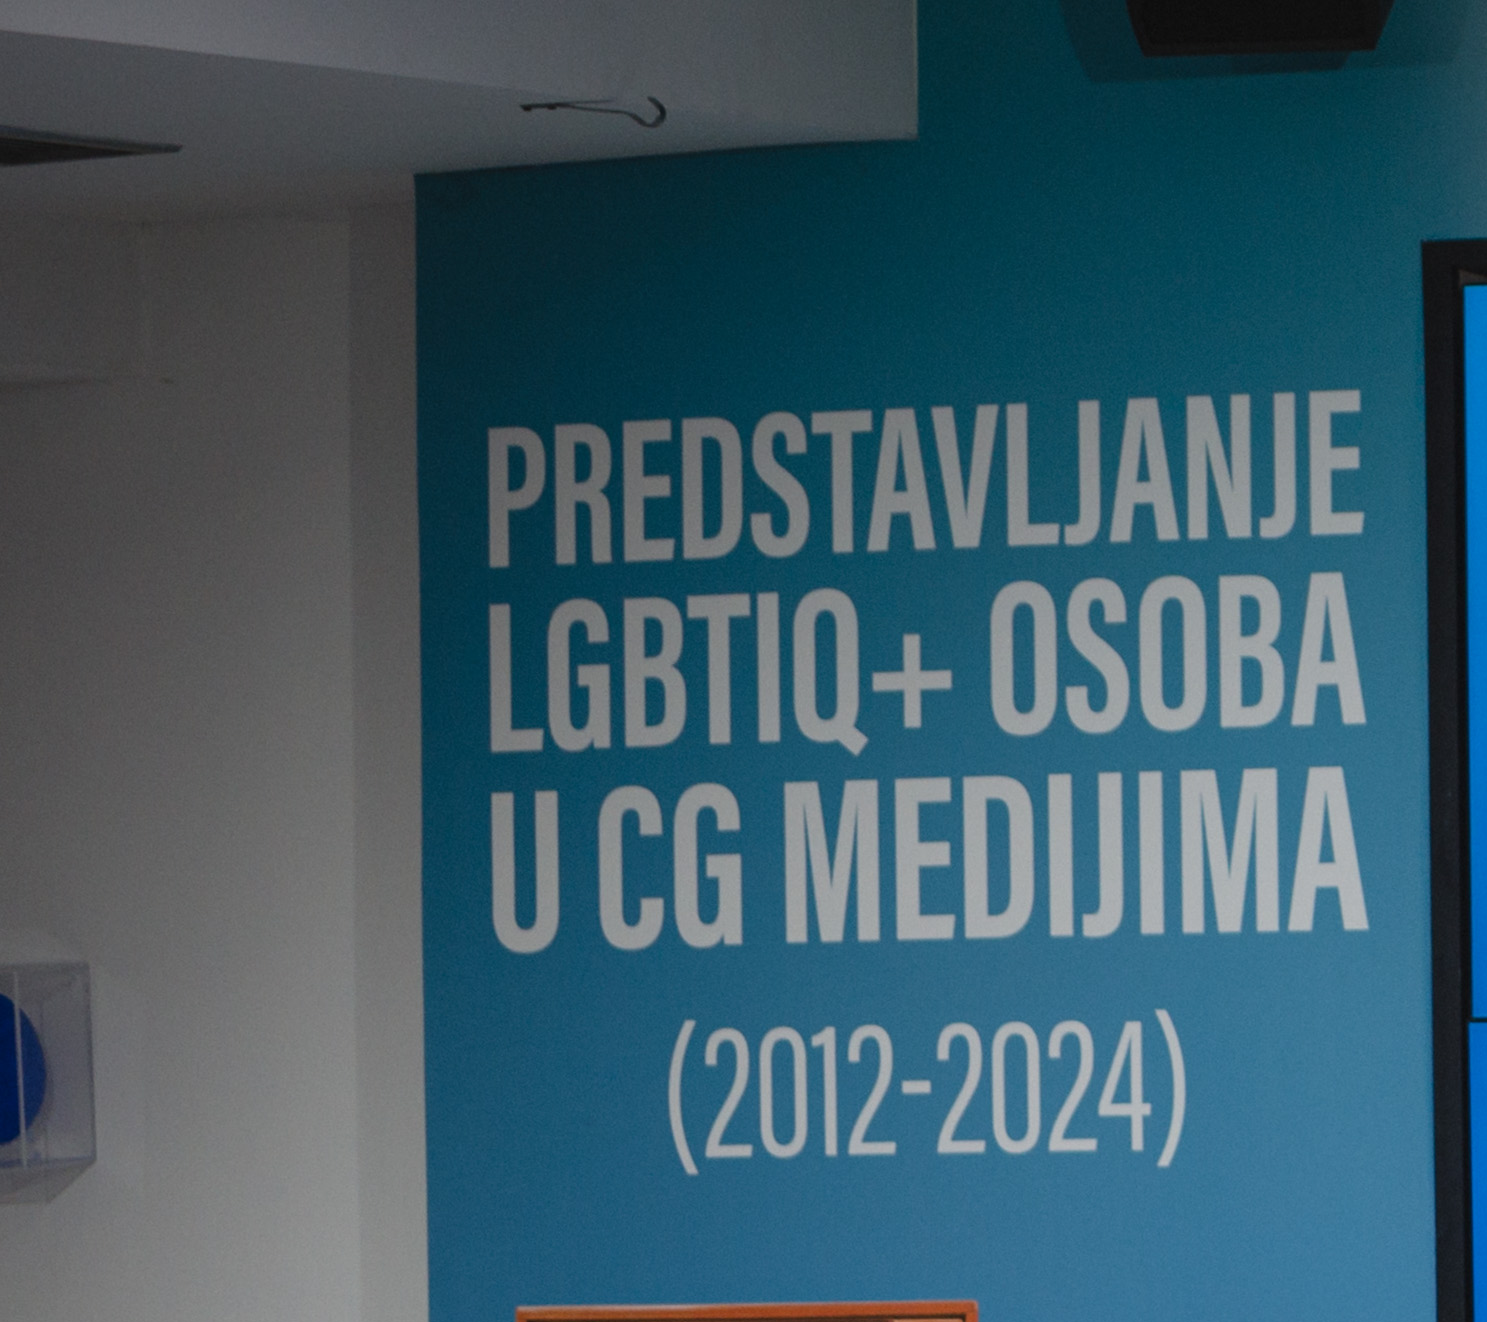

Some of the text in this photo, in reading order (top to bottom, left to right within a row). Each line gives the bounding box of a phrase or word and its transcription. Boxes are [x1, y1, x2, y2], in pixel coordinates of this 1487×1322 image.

[488, 389, 1366, 568] PREDSTAVLJANJE
[489, 572, 1367, 756] LGBTIQ+ OSOBA
[490, 766, 1369, 954] U CG MEDIJIMA
[668, 1009, 1187, 1175] (2012-2024)
